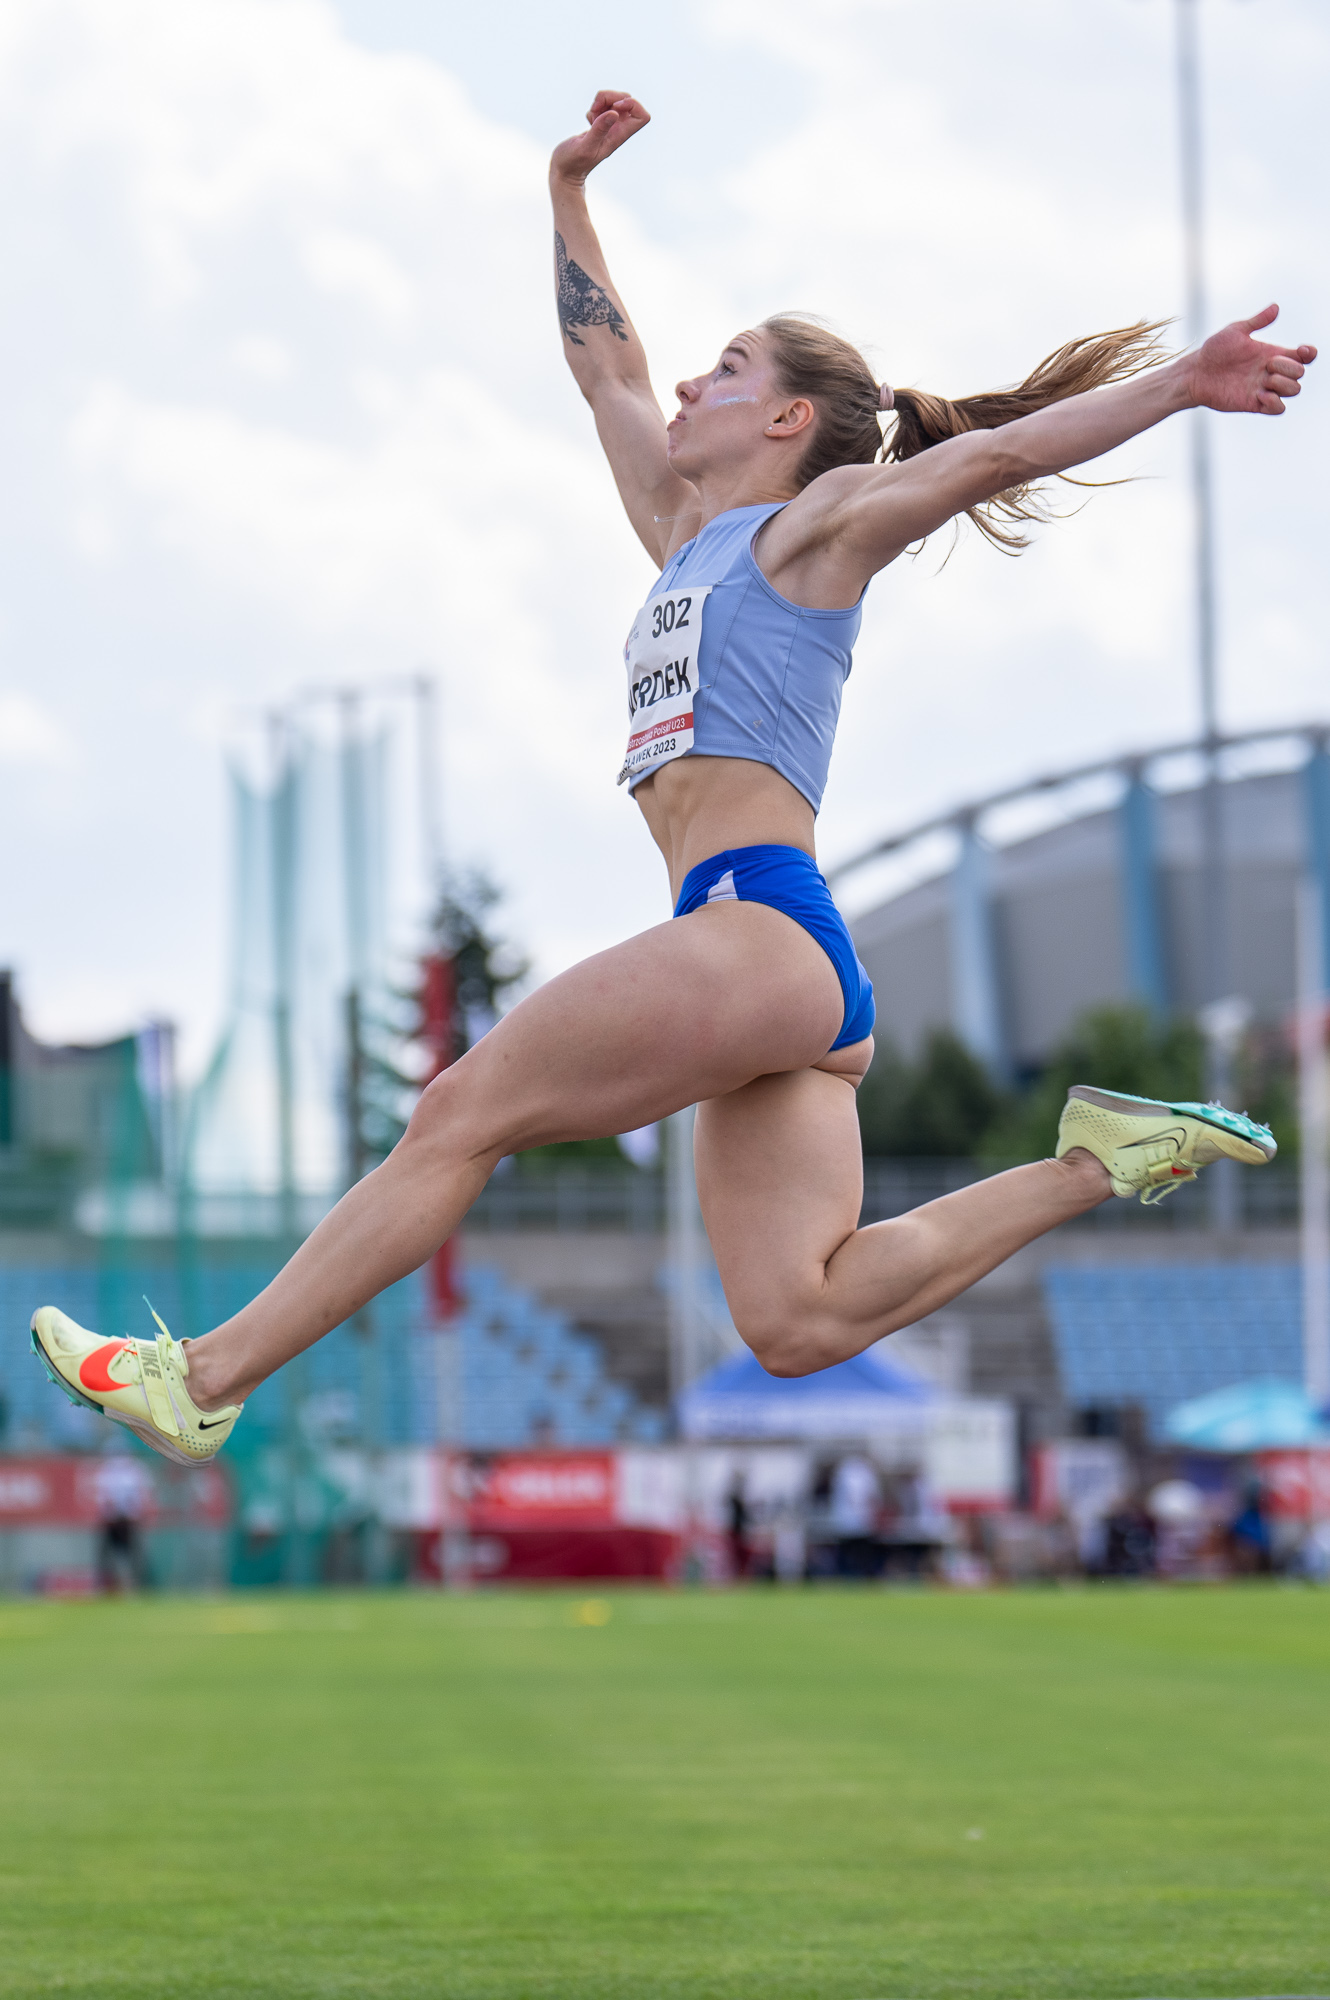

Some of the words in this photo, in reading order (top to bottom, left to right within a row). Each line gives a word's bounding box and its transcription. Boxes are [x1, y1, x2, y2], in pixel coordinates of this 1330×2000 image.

[652, 597, 691, 639] 302
[653, 722, 671, 737] Polski
[671, 717, 685, 730] U23
[653, 738, 676, 756] 2023
[138, 1343, 162, 1380] NIKE
